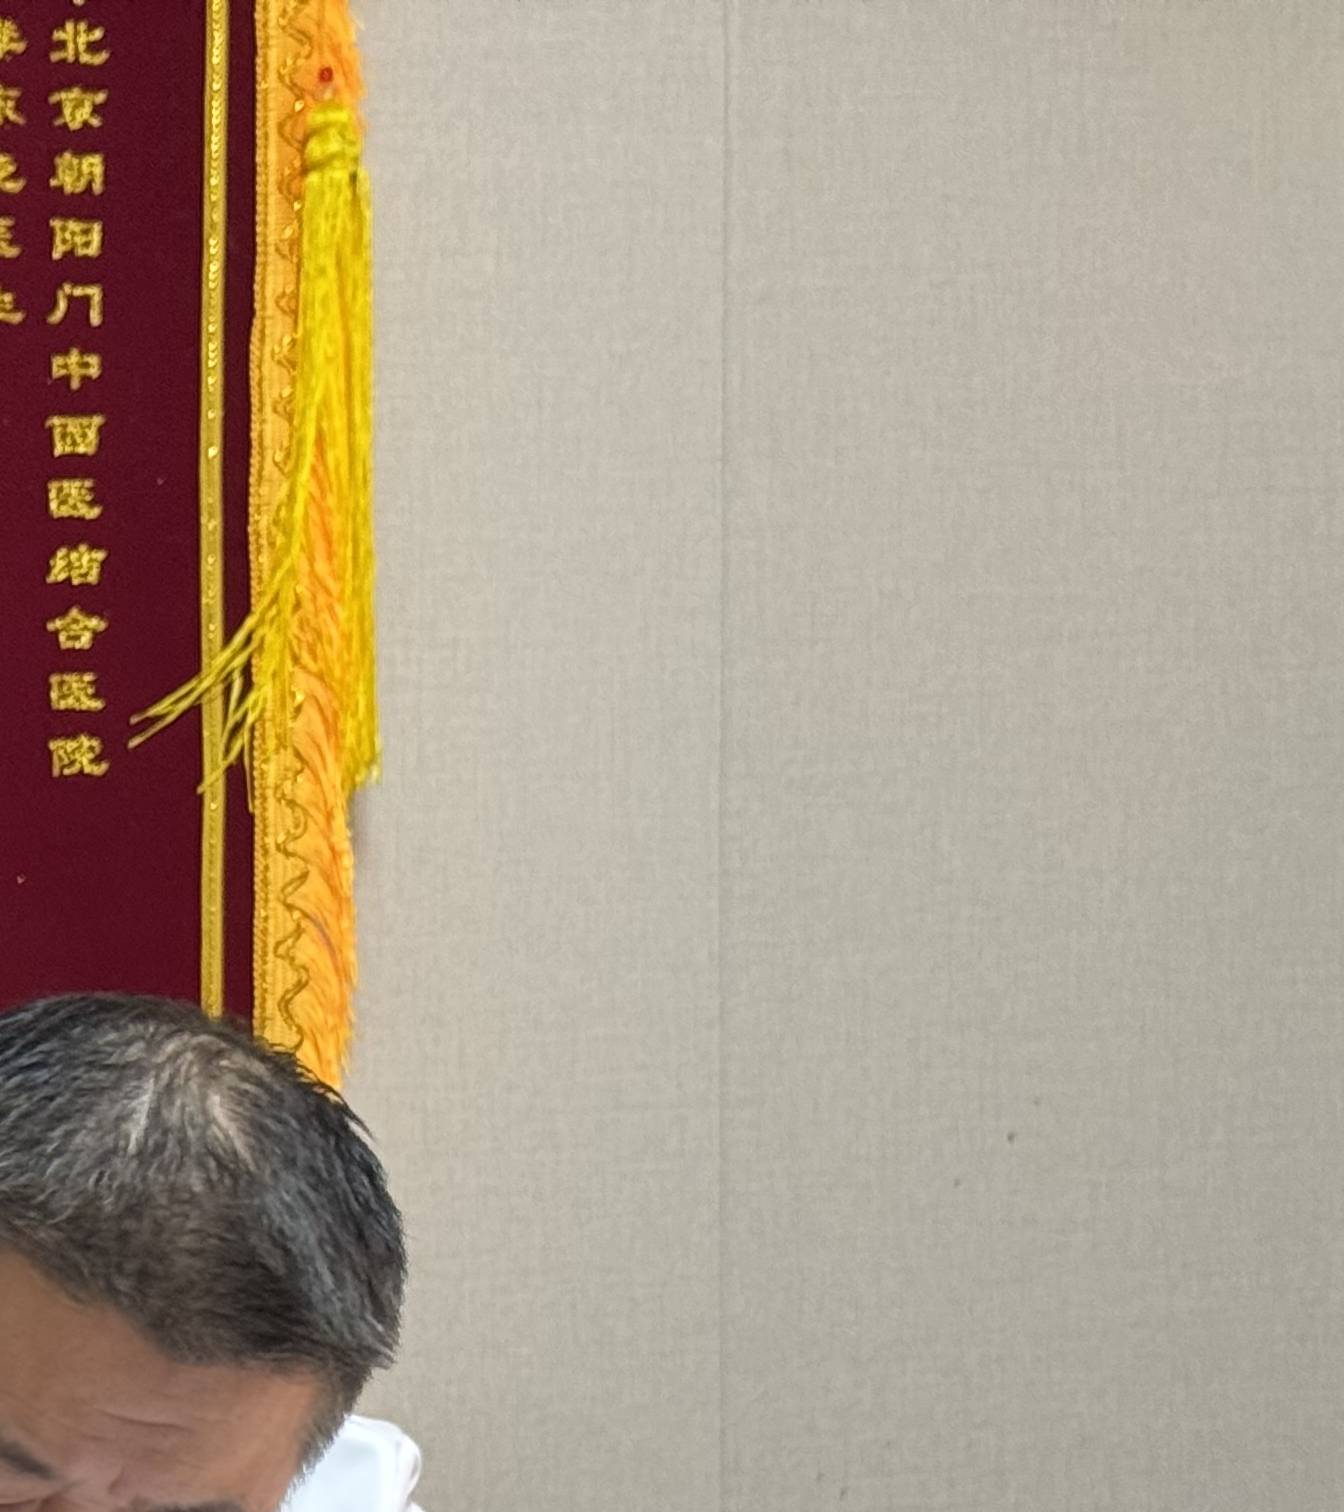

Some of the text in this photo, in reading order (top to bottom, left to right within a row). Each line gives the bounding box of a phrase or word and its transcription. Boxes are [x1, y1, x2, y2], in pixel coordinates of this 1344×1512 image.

[46, 19, 110, 778] 北京朝阳门中西医结合医院
